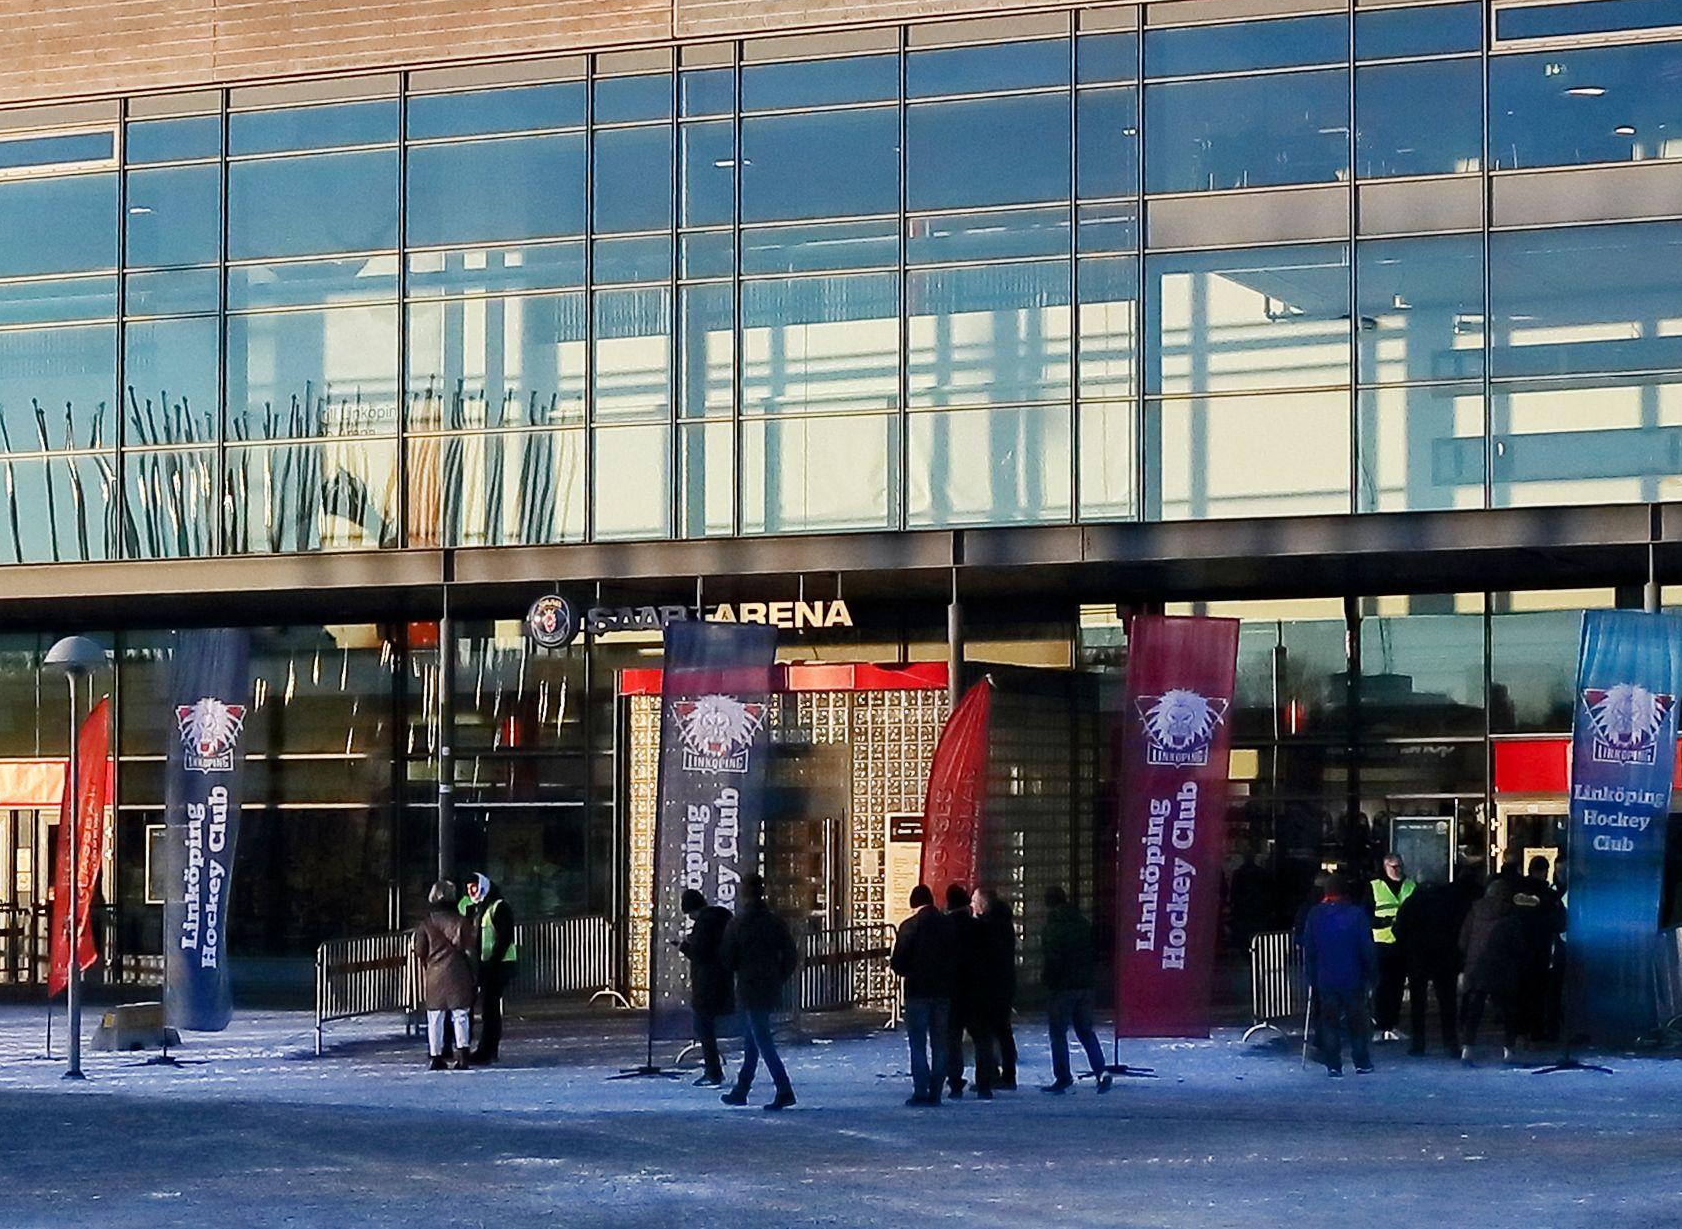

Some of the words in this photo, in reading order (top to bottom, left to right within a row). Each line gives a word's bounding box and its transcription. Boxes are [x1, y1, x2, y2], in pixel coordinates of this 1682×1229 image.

[587, 605, 688, 635] SAAB
[707, 600, 854, 628] ARENA
[208, 785, 228, 852] Club
[713, 786, 740, 864] Club
[1172, 781, 1198, 850] Club
[1574, 784, 1665, 809] Linköping
[1583, 809, 1651, 831] Hockey
[181, 802, 206, 950] Linköping
[1136, 798, 1171, 951] Linköping
[1593, 835, 1634, 852] Club
[201, 858, 227, 969] Hockey
[1162, 857, 1196, 970] Hockey
